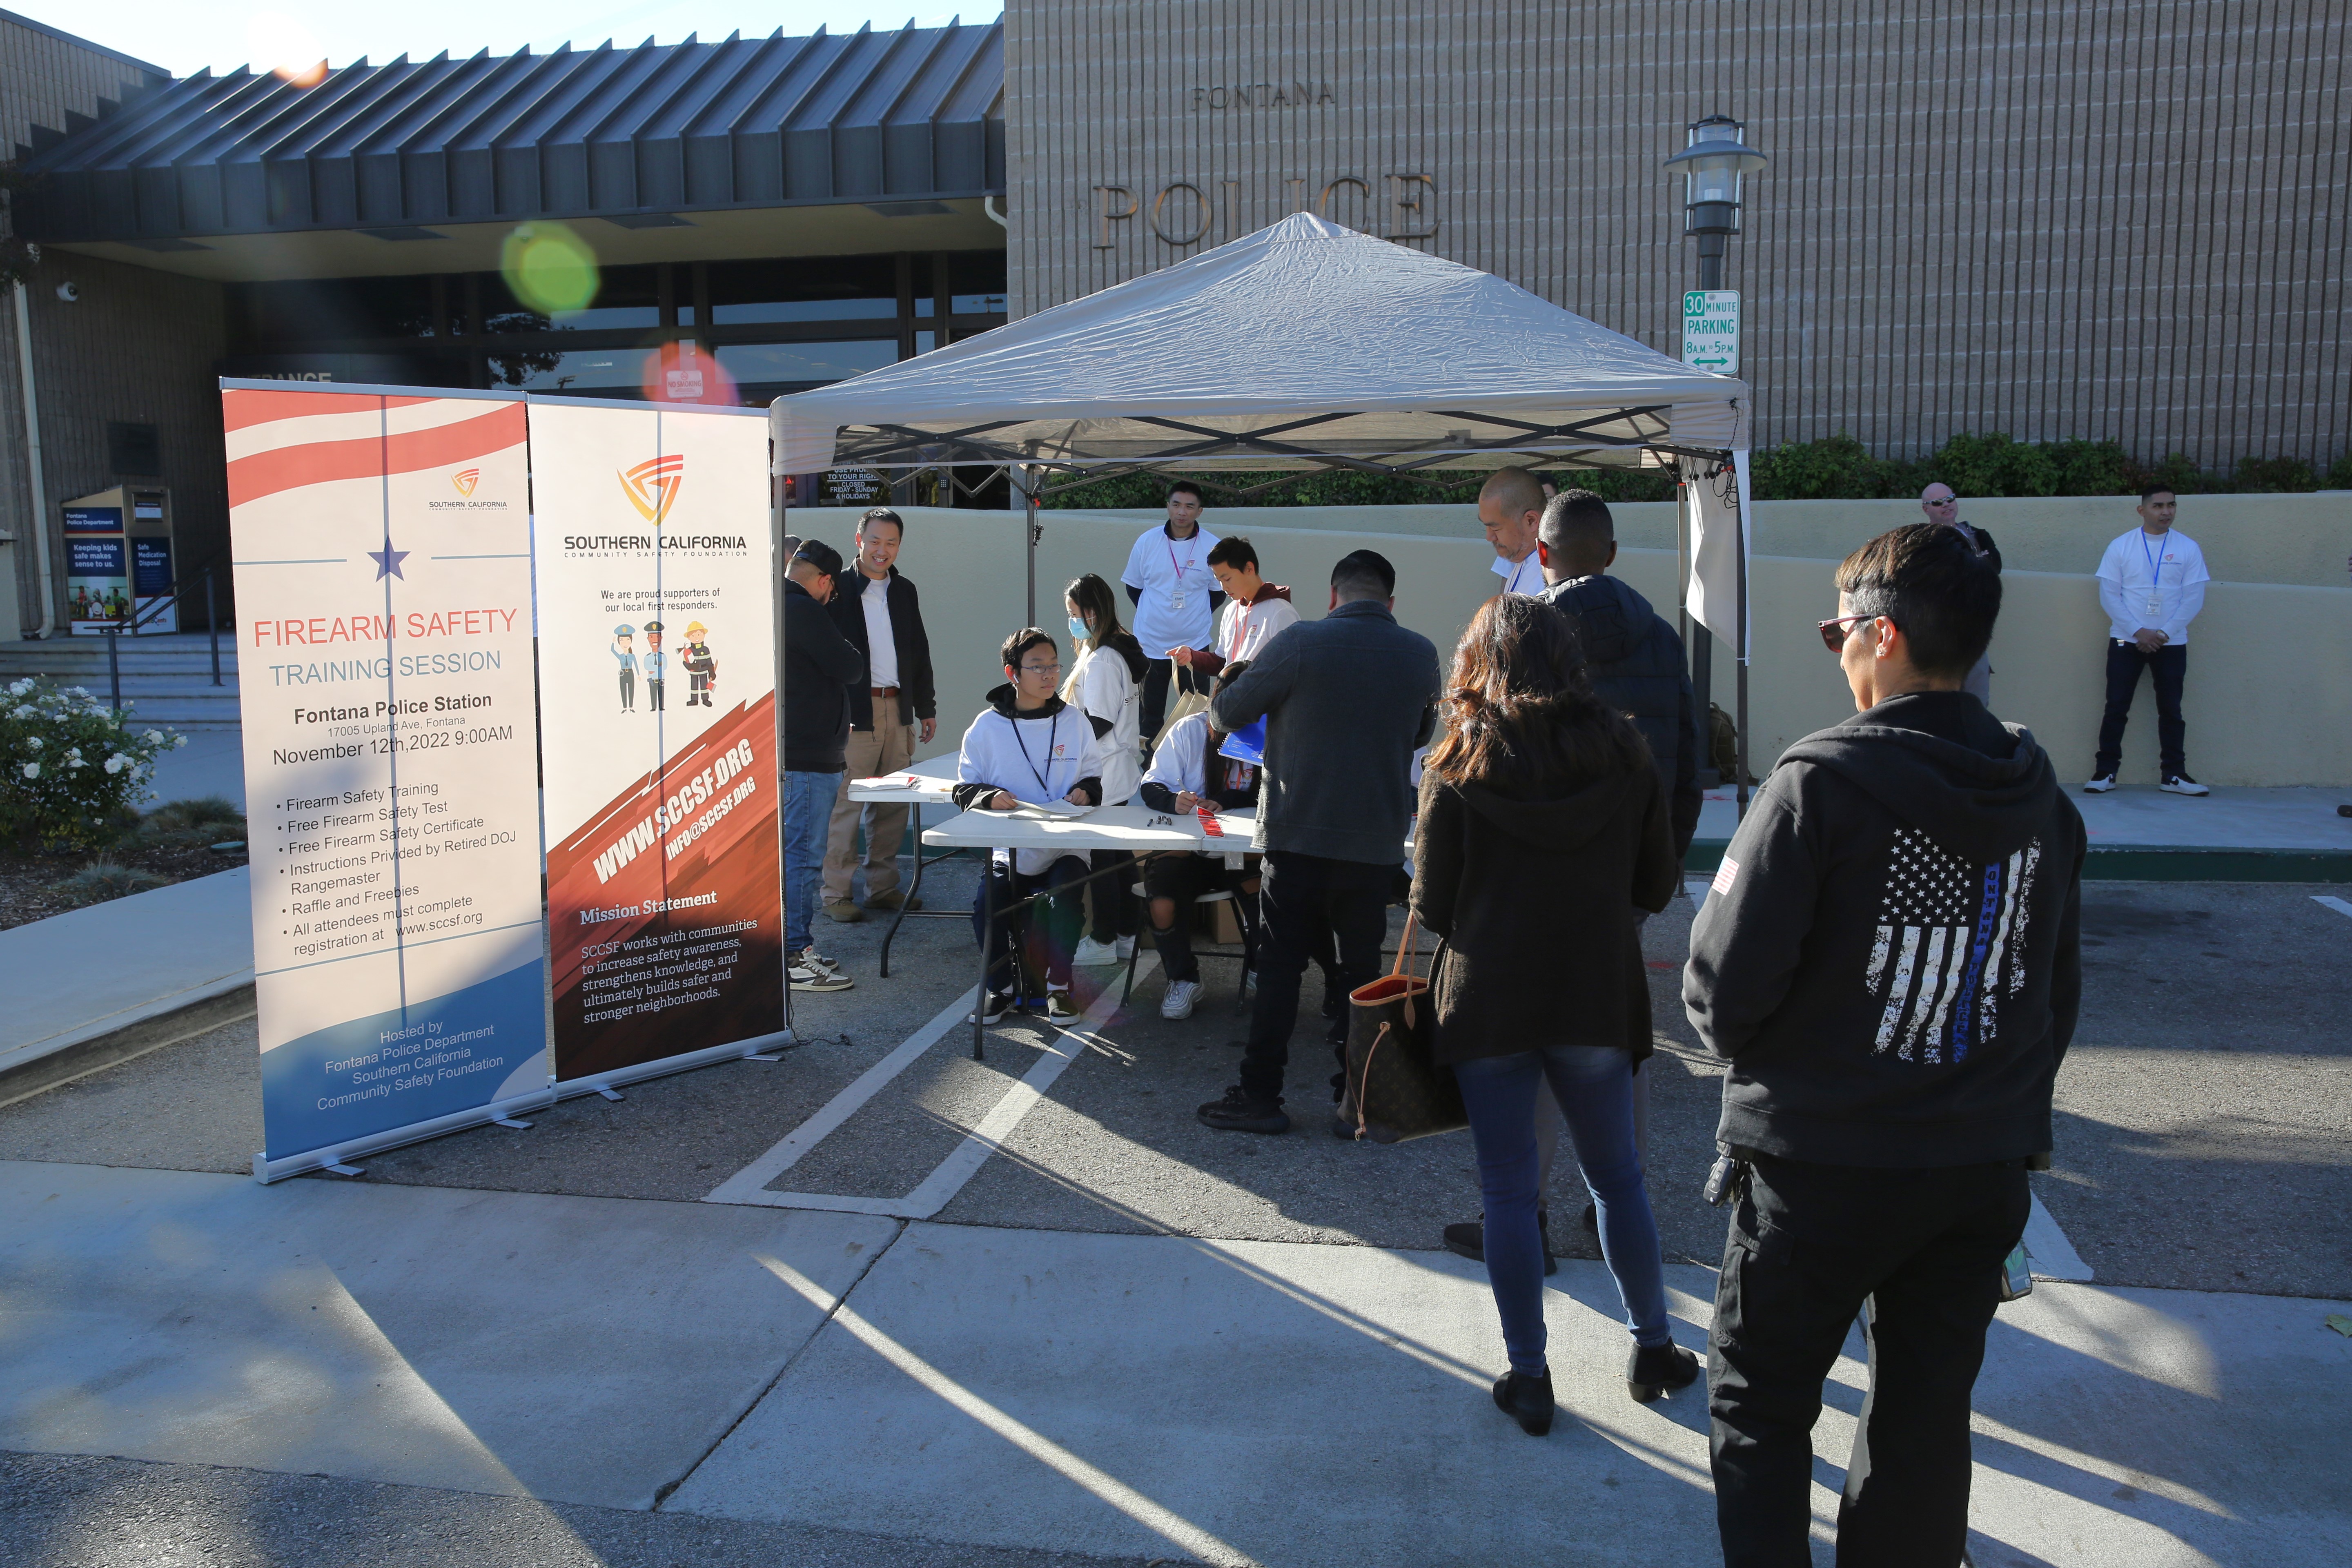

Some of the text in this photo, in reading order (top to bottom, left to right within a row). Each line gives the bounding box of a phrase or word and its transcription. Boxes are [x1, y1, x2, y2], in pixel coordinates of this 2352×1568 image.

[1191, 82, 1336, 111] FONTANA
[1686, 296, 1736, 314] 30 MINUTE
[1688, 319, 1734, 334] PARKING
[564, 536, 746, 550] SOUTHERN CALIFORNIA
[601, 590, 614, 599] We
[635, 589, 661, 601] proud
[663, 589, 710, 600] supporters
[712, 588, 720, 597] of
[623, 602, 644, 612] local
[648, 602, 664, 611] first
[668, 601, 717, 612] responders.
[254, 608, 517, 647] FIREARM SAFETY
[269, 650, 501, 686] TRAINING SESSION
[294, 694, 492, 725] Fontana Police Station
[328, 716, 466, 738] 17005 Upland Ave, Fontana
[273, 725, 513, 766] November 12th,2022 9:00AM
[287, 782, 439, 812] Firearm Safety Training
[593, 738, 754, 884] WWW.SCCSF.ORG
[287, 801, 448, 833] Free Firearm Safety Test
[665, 776, 756, 861] INFO@SCCSF.ORG
[289, 817, 484, 855] Free Firearm Safety Certificate
[290, 831, 516, 876] Instructions Privided by Retired DOJ
[291, 871, 381, 895] Rangemaster
[292, 884, 419, 915] Raffle and Freebies
[293, 897, 472, 937] All attendees must complete
[580, 890, 717, 925] Mission Statement
[1976, 865, 1996, 946] ONTANA
[294, 912, 482, 956] registration at www.sccsf.org
[581, 919, 757, 958] SCCSF works with communities
[582, 938, 741, 974] to increase safety awareness,
[583, 952, 737, 991] strengthens knowledge, and
[584, 968, 731, 1007] ultimately builds safer and
[584, 987, 720, 1024] stronger neighborhoods.
[325, 1024, 494, 1074] Fontana Police Department
[381, 1021, 443, 1044] Hosted by
[317, 1056, 503, 1110] Community Safety Foundation
[353, 1047, 471, 1085] Southern California
